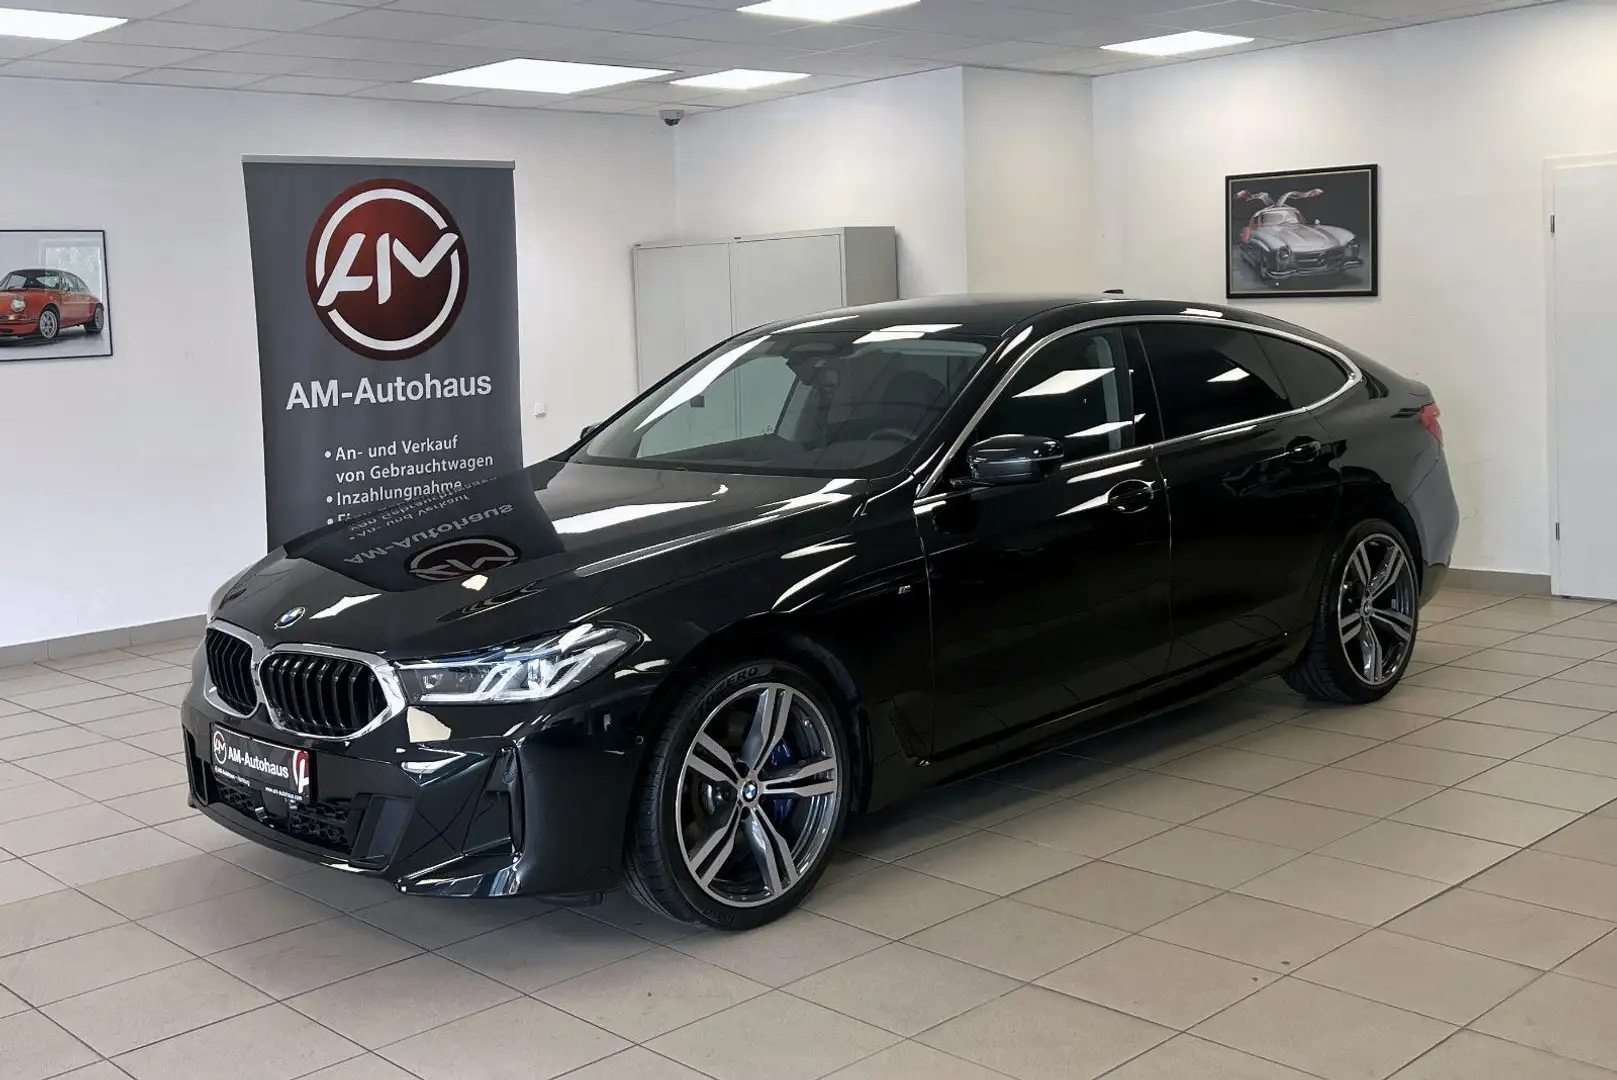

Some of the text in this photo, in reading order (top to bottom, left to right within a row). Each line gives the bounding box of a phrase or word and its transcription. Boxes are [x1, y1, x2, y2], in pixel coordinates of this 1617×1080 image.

[317, 232, 459, 307] AM
[286, 373, 492, 411] AM-Autohaus
[335, 435, 459, 462] An- und Verkauf
[336, 454, 494, 483] von Gebrauchtwagen
[337, 479, 462, 507] Inzahlungnahme
[228, 746, 289, 779] AM-Autohaus
